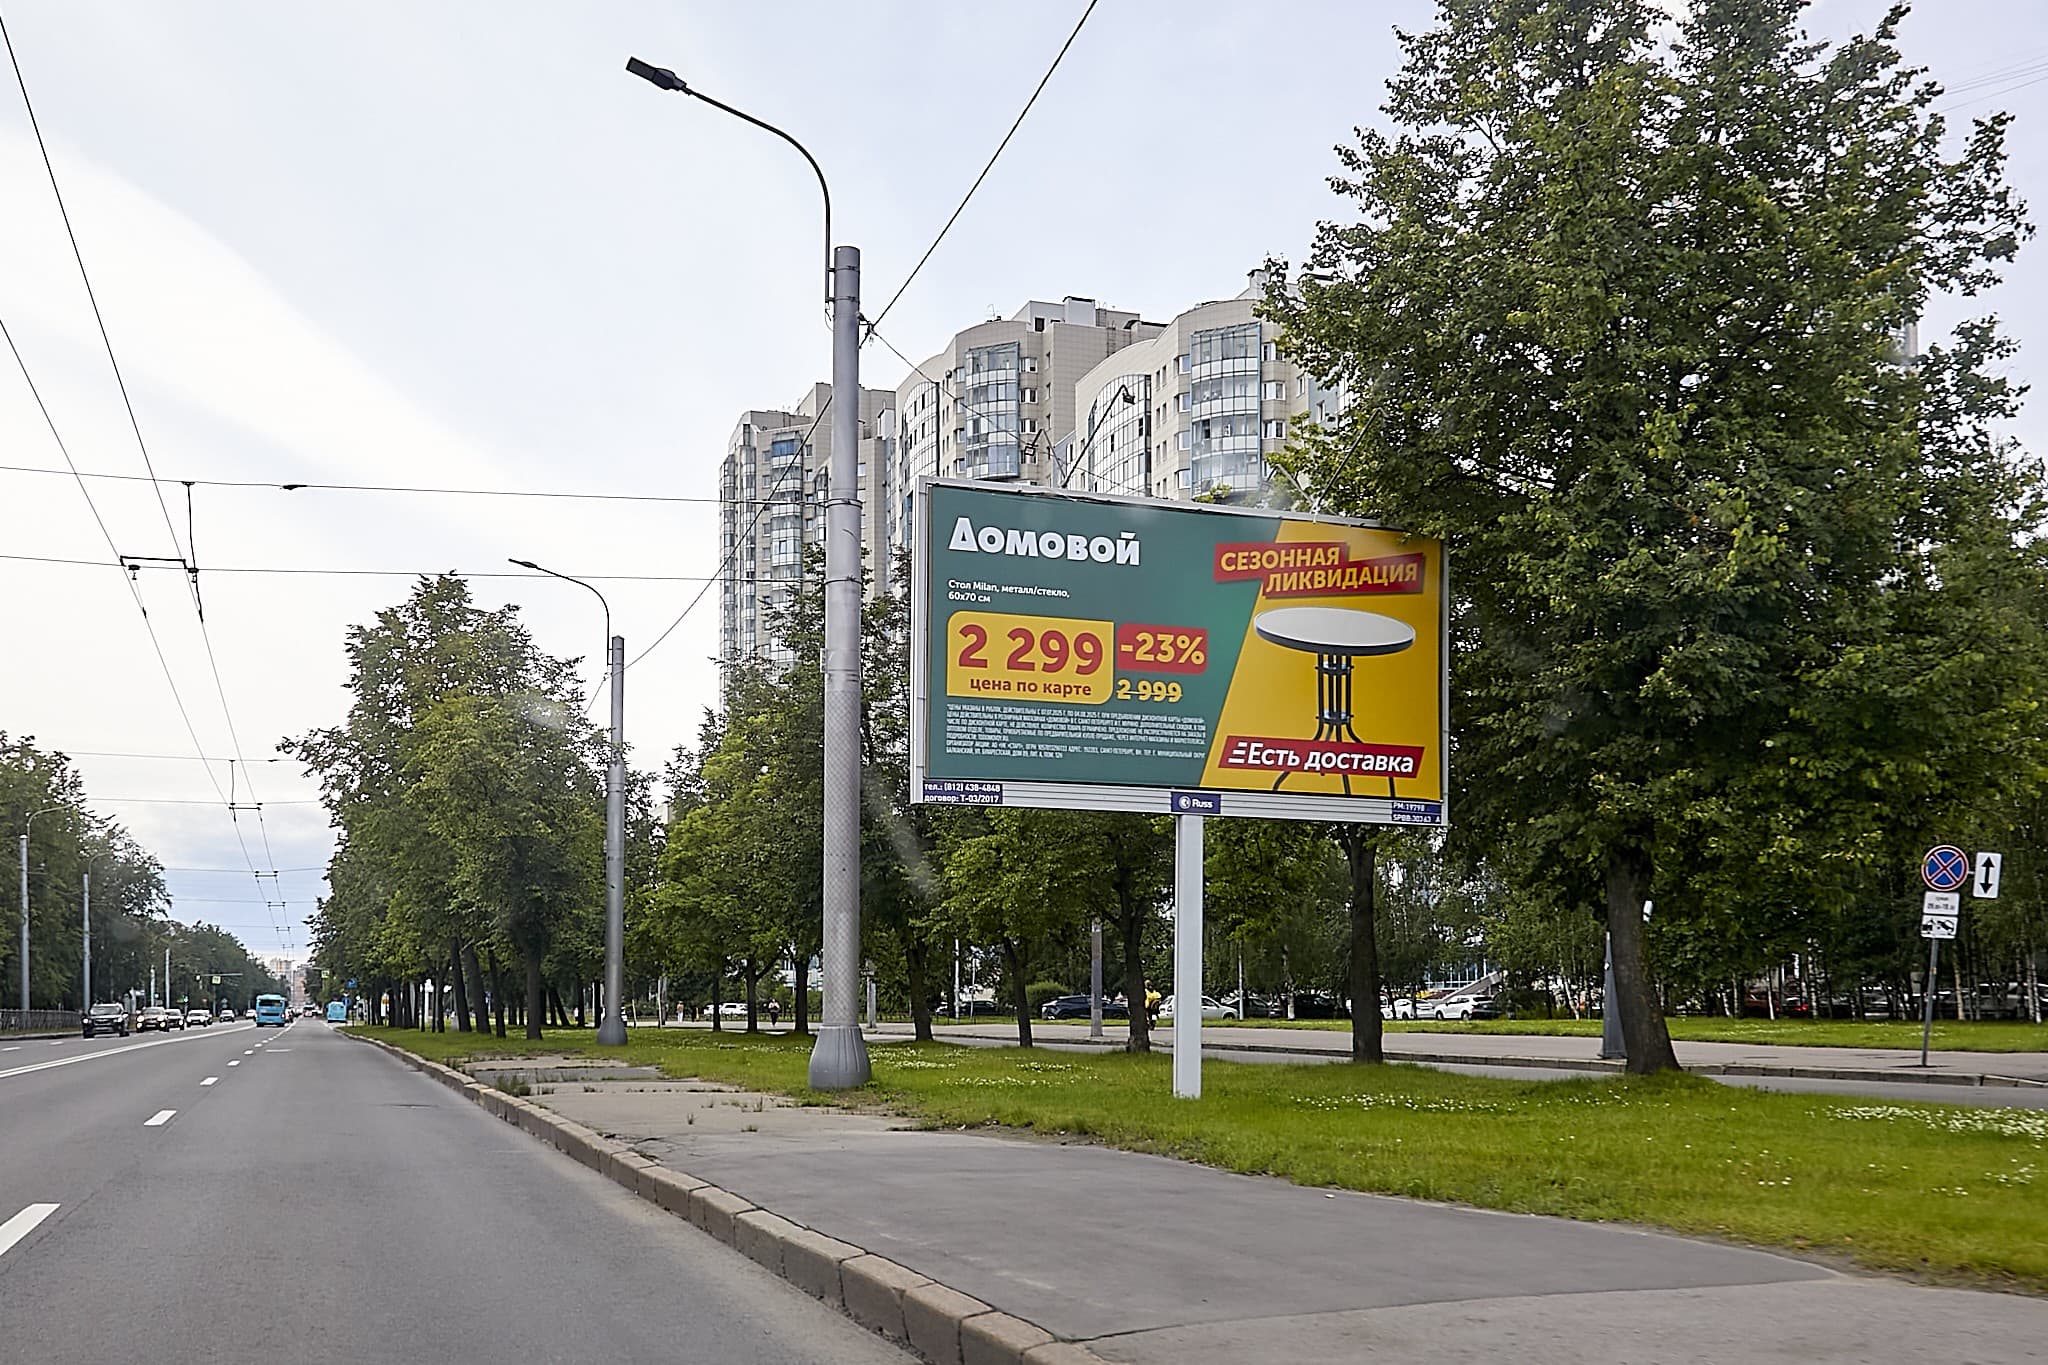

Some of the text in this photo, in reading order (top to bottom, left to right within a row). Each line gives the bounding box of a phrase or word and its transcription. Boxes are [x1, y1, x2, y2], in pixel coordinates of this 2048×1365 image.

[1220, 546, 1340, 572] СЕЗОННАЯ
[1265, 562, 1417, 593] ЛИКВИДАЦИЯ
[948, 579, 1070, 599] Стол Milan, металл/стекло,
[978, 594, 991, 603] см
[958, 624, 1104, 676] 2 299
[1120, 632, 1205, 666] -23%
[969, 678, 1092, 698] цена по карте
[1116, 679, 1182, 703] 2 999
[1247, 742, 1414, 773] Есть доставка
[944, 782, 964, 792] (812)
[924, 794, 959, 803] договор:
[1191, 798, 1213, 809] Russ
